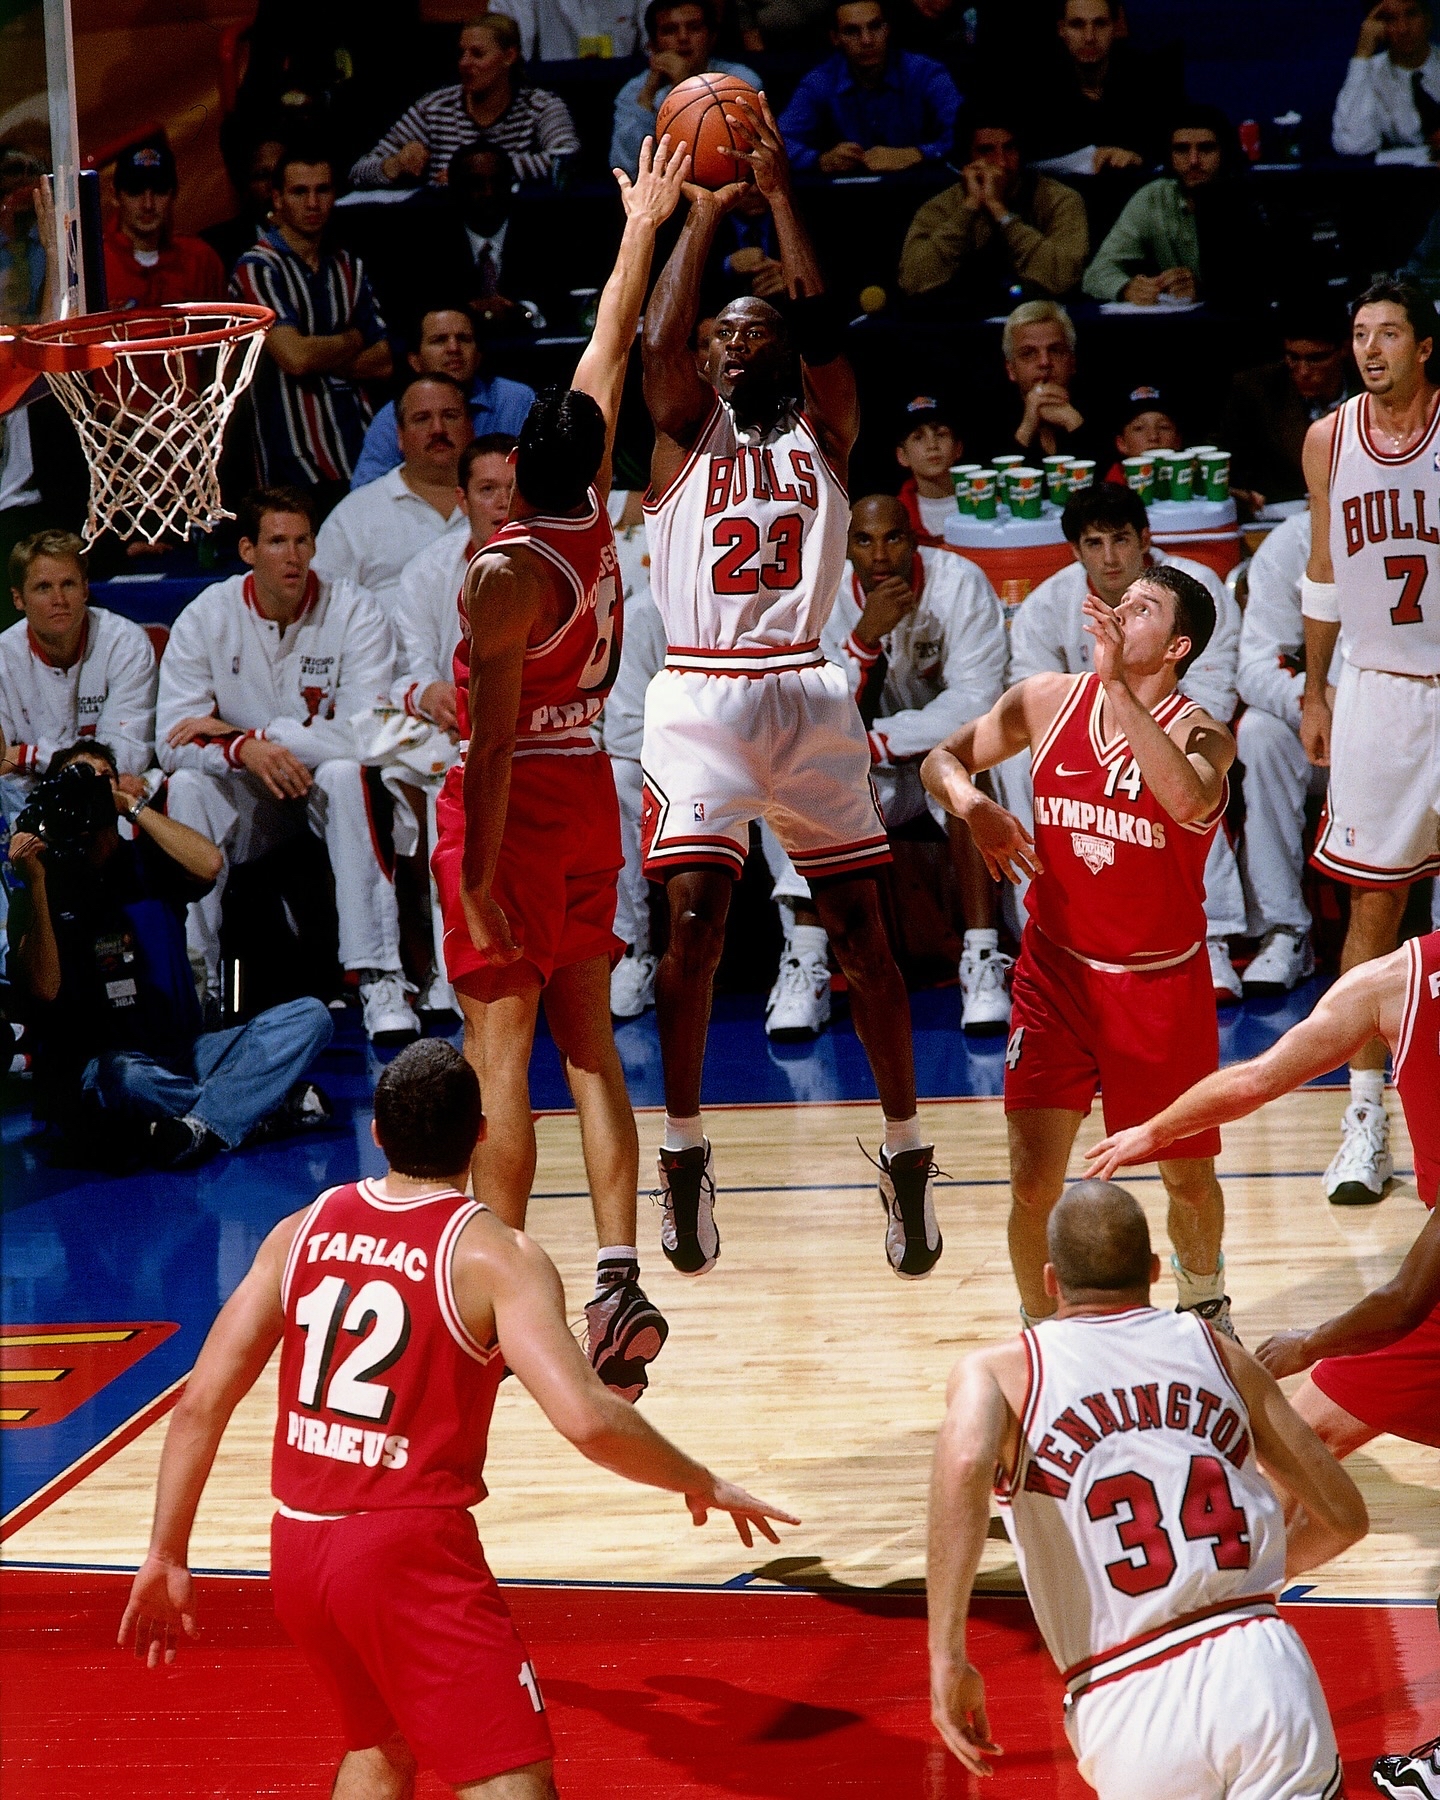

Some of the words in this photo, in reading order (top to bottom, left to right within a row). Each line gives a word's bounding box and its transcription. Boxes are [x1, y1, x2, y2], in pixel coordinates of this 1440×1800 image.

[705, 446, 818, 519] BULLS
[711, 513, 804, 595] 23
[1342, 488, 1440, 558] BULL
[1384, 555, 1428, 626] 7
[1103, 754, 1142, 802] 14
[1034, 796, 1166, 849] OLYMPIAKOS
[1005, 1026, 1024, 1070] 4
[306, 1231, 428, 1282] TARLAC
[295, 1274, 411, 1425] 12
[286, 1410, 410, 1470] PIRAEUS
[1023, 1381, 1251, 1500] WENNINGTON
[1084, 1454, 1251, 1598] 34
[517, 1659, 545, 1713] 1
